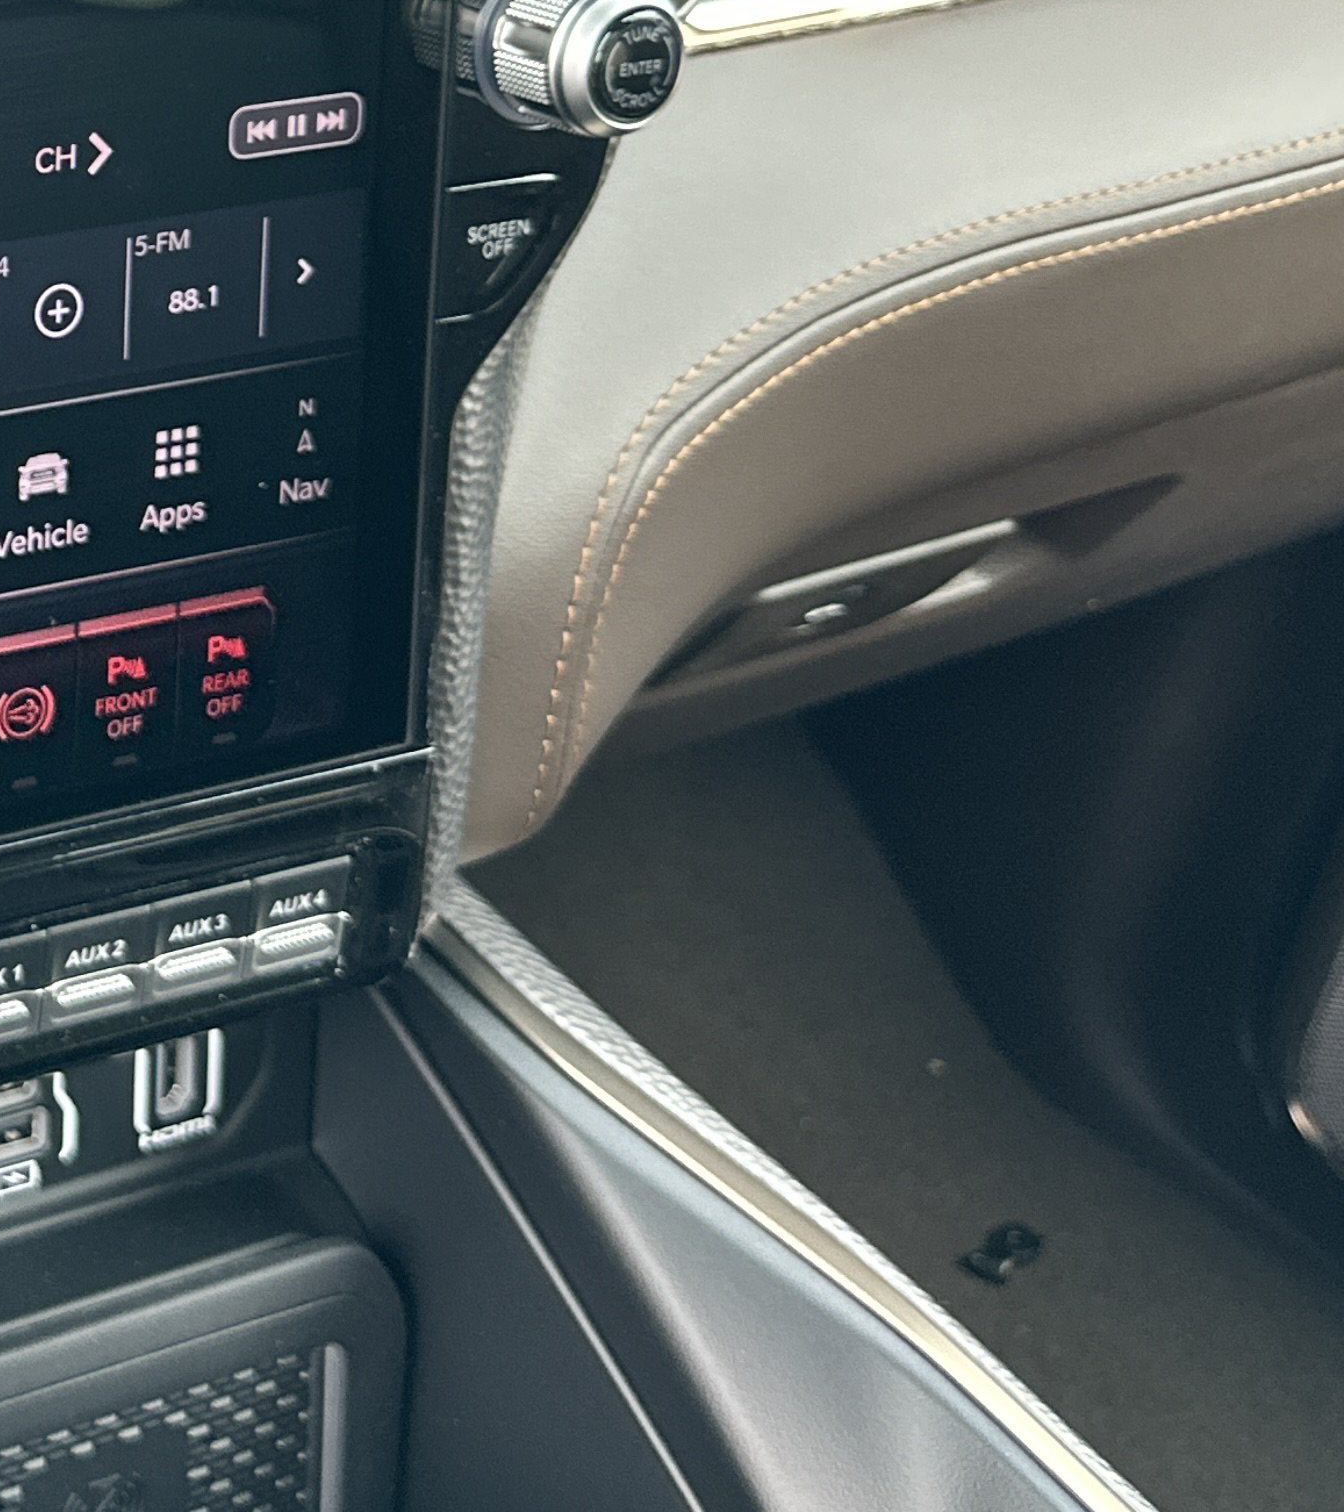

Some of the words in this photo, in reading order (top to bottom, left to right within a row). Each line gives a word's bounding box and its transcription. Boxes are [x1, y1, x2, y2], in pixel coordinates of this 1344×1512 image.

[619, 58, 663, 78] ENTER
[34, 144, 77, 174] CH
[134, 229, 192, 257] 5-FM
[467, 219, 532, 245] SCREEN
[482, 240, 515, 260] OFF
[168, 284, 219, 314] 88.1
[299, 399, 314, 417] N
[278, 478, 329, 505] Nav
[140, 500, 206, 533] Apps
[202, 670, 249, 694] REAR
[95, 688, 157, 717] FRONT
[205, 695, 242, 718] OFF
[107, 716, 143, 739] OFF
[268, 896, 313, 918] AUX
[312, 889, 328, 910] 4
[168, 921, 214, 943] AUX
[212, 914, 228, 935] 3
[65, 947, 111, 968] AUX
[112, 939, 127, 961] 2
[12, 963, 25, 984] 1
